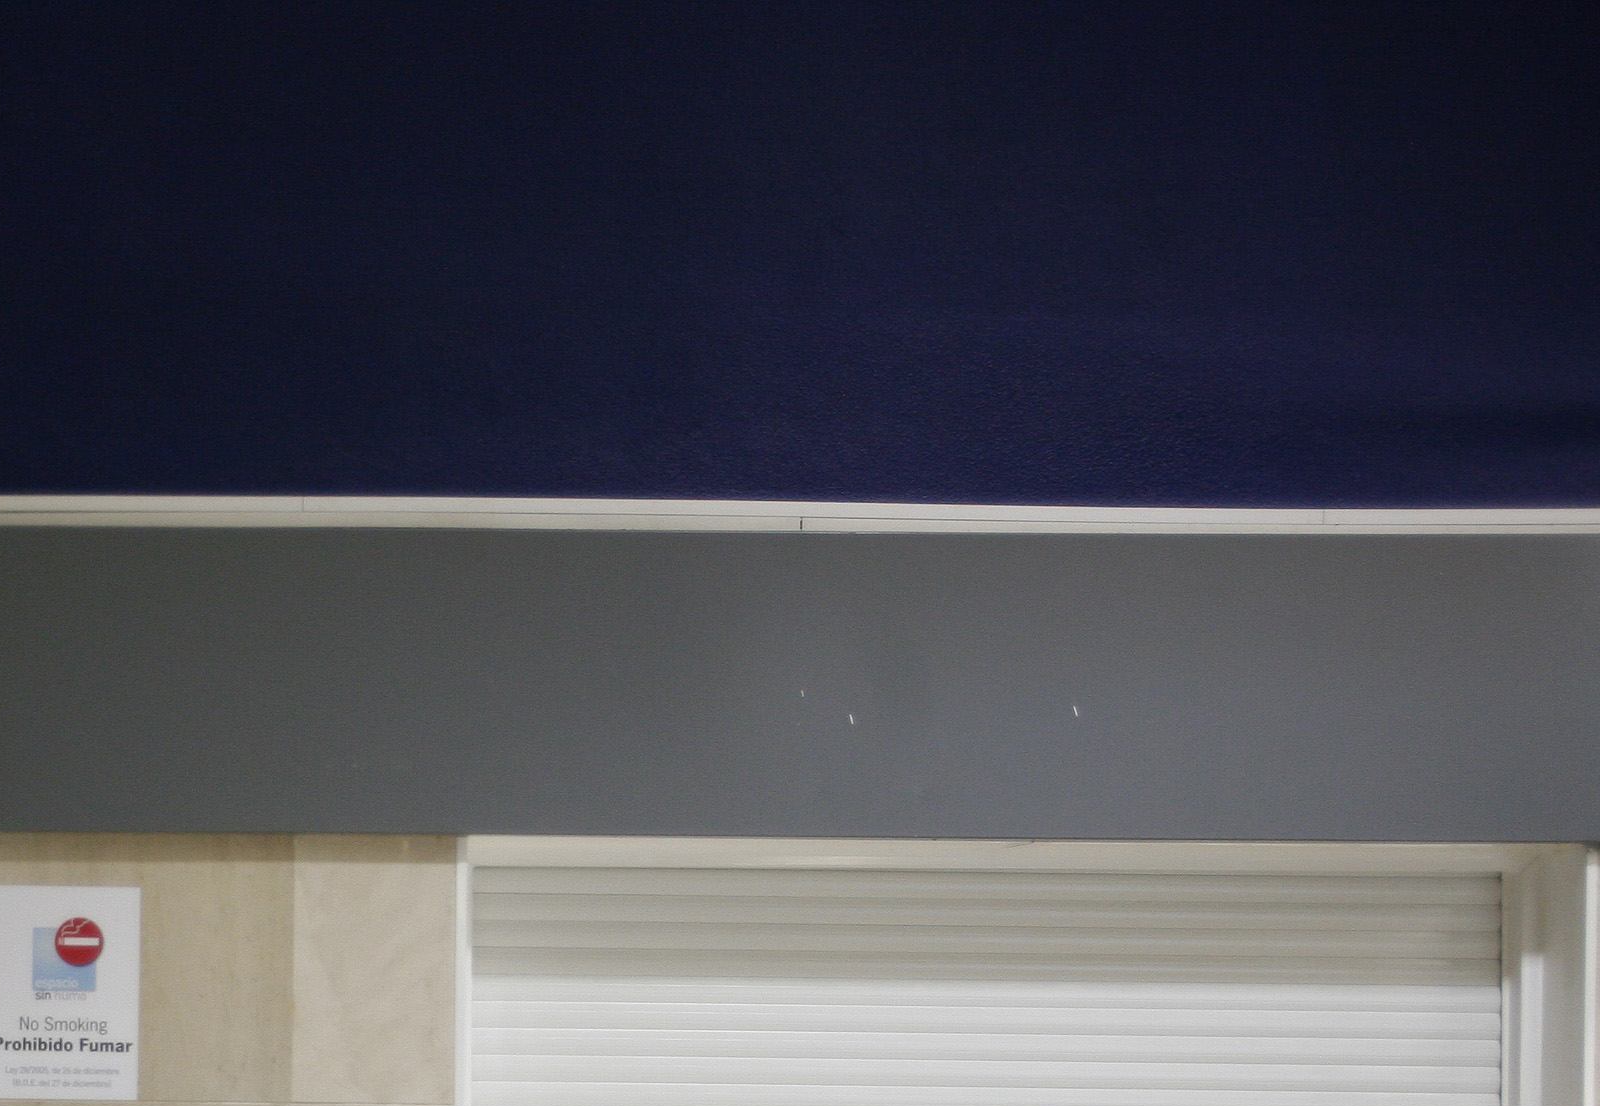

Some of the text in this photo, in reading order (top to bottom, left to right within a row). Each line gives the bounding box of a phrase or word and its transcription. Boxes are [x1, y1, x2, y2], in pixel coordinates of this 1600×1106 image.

[35, 990, 51, 1001] sin
[19, 1016, 108, 1035] No Smoking
[79, 1037, 133, 1053] Fumar
